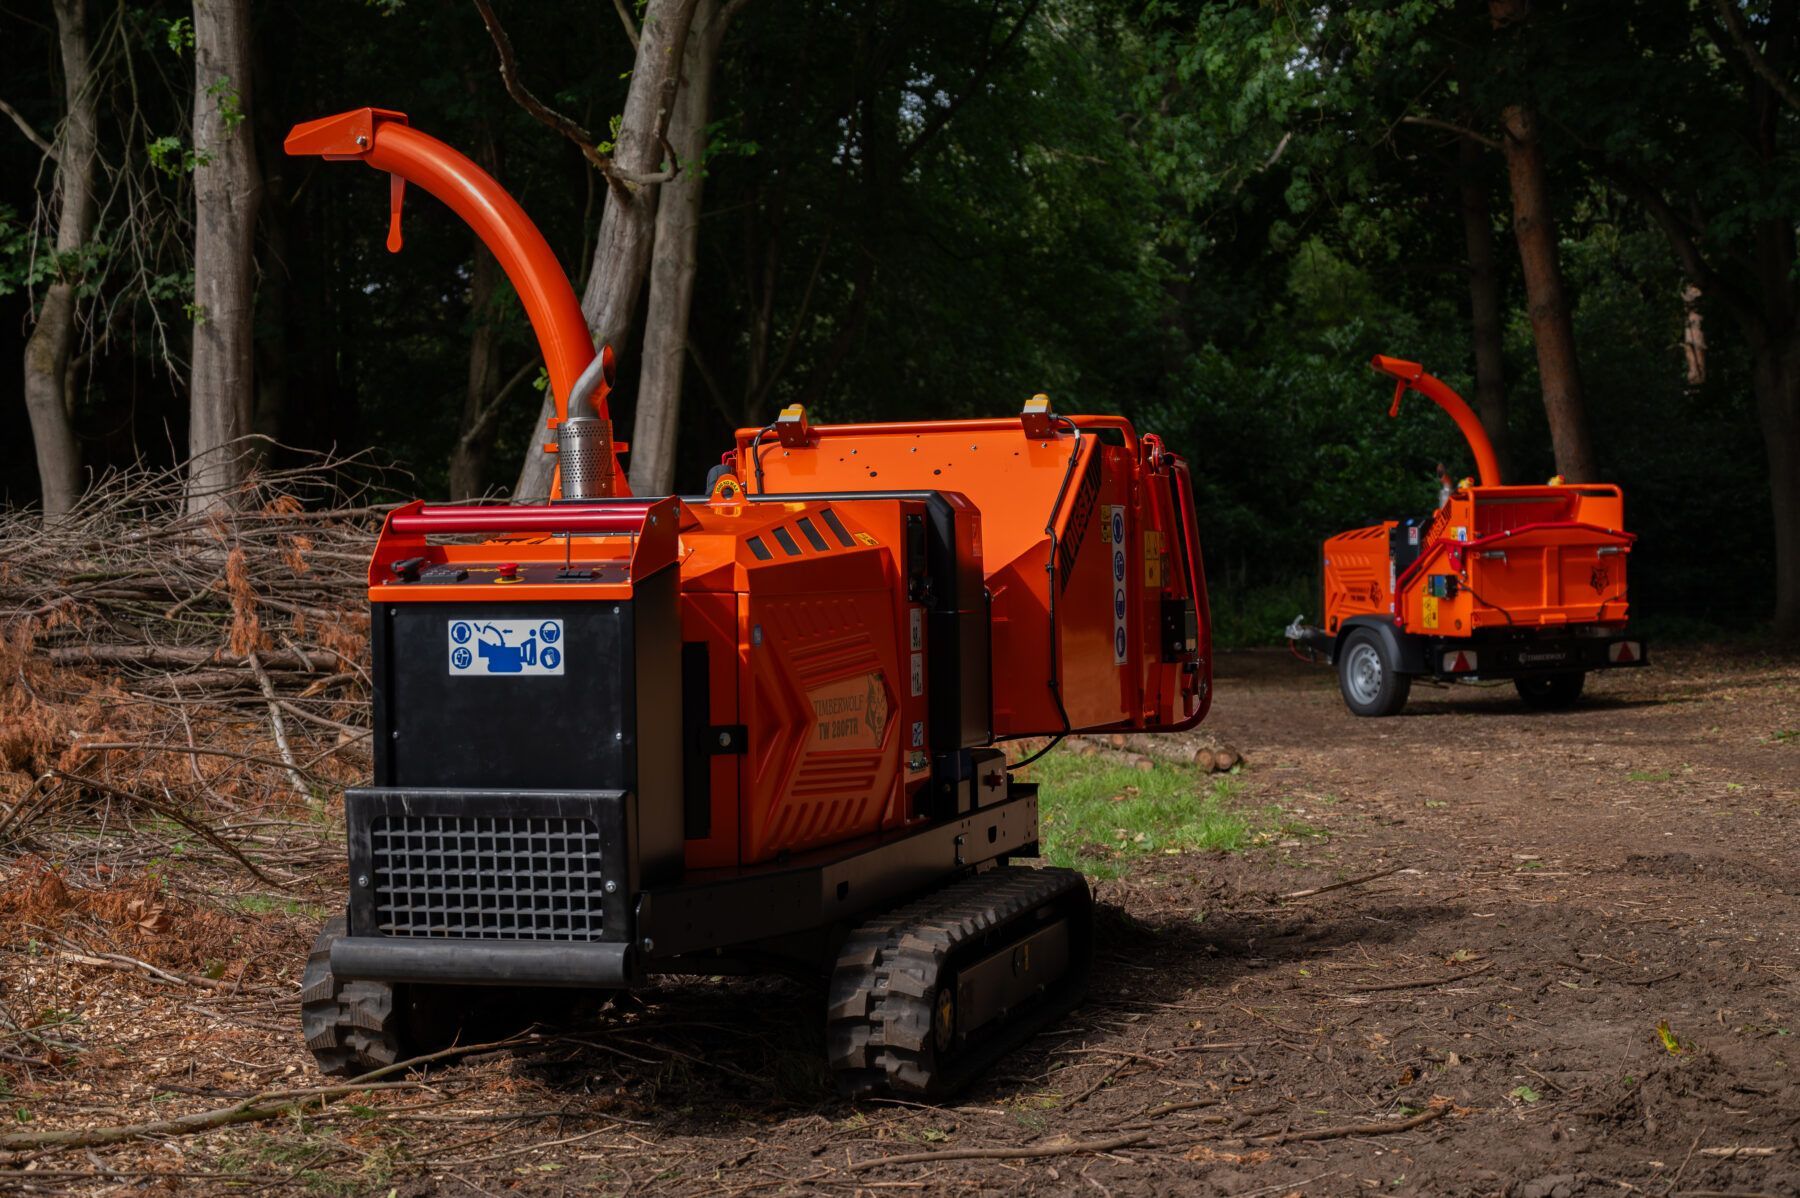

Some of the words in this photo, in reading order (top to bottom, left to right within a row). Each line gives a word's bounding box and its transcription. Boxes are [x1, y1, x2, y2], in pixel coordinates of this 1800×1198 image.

[1064, 480, 1097, 555] DIESEL
[814, 695, 864, 716] TIMBERWOLF
[818, 721, 829, 740] TW
